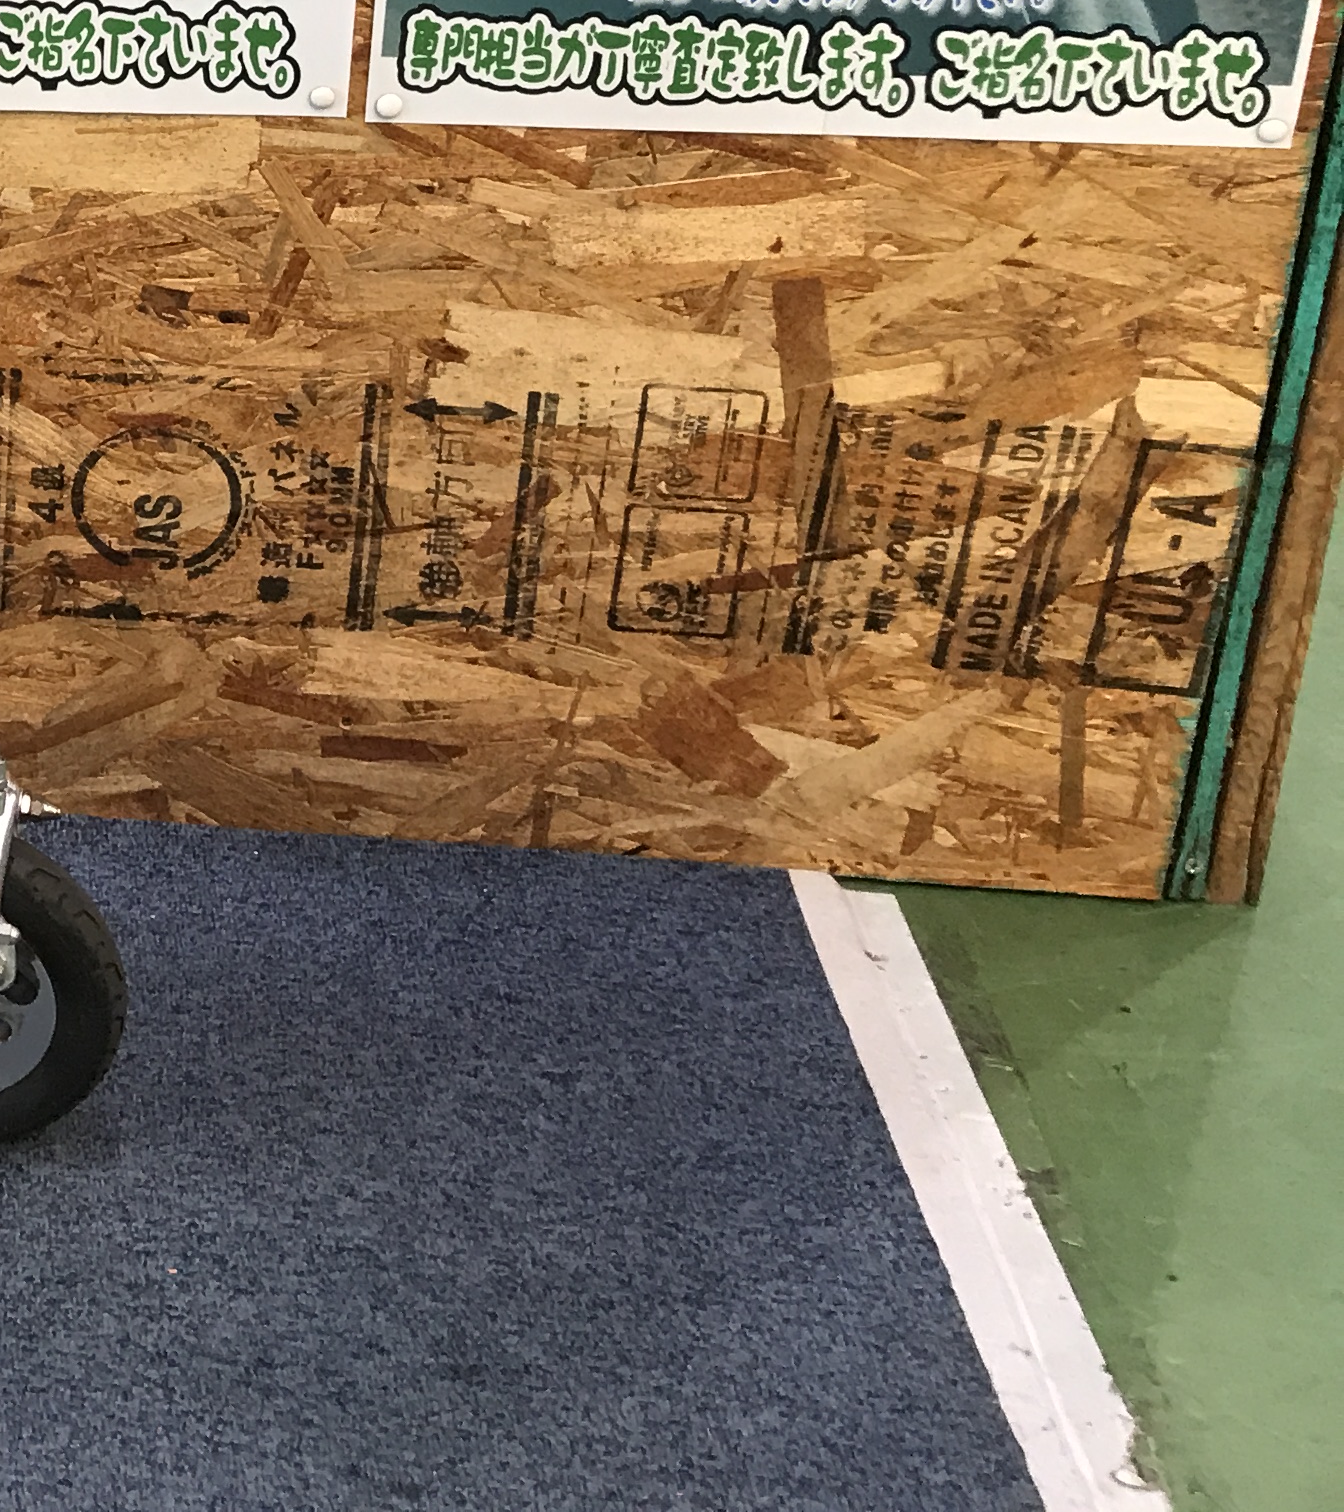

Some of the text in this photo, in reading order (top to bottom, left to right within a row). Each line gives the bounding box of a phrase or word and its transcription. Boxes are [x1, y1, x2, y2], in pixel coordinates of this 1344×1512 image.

[132, 492, 183, 571] JAS
[958, 424, 1052, 673] MADE IN CANADA
